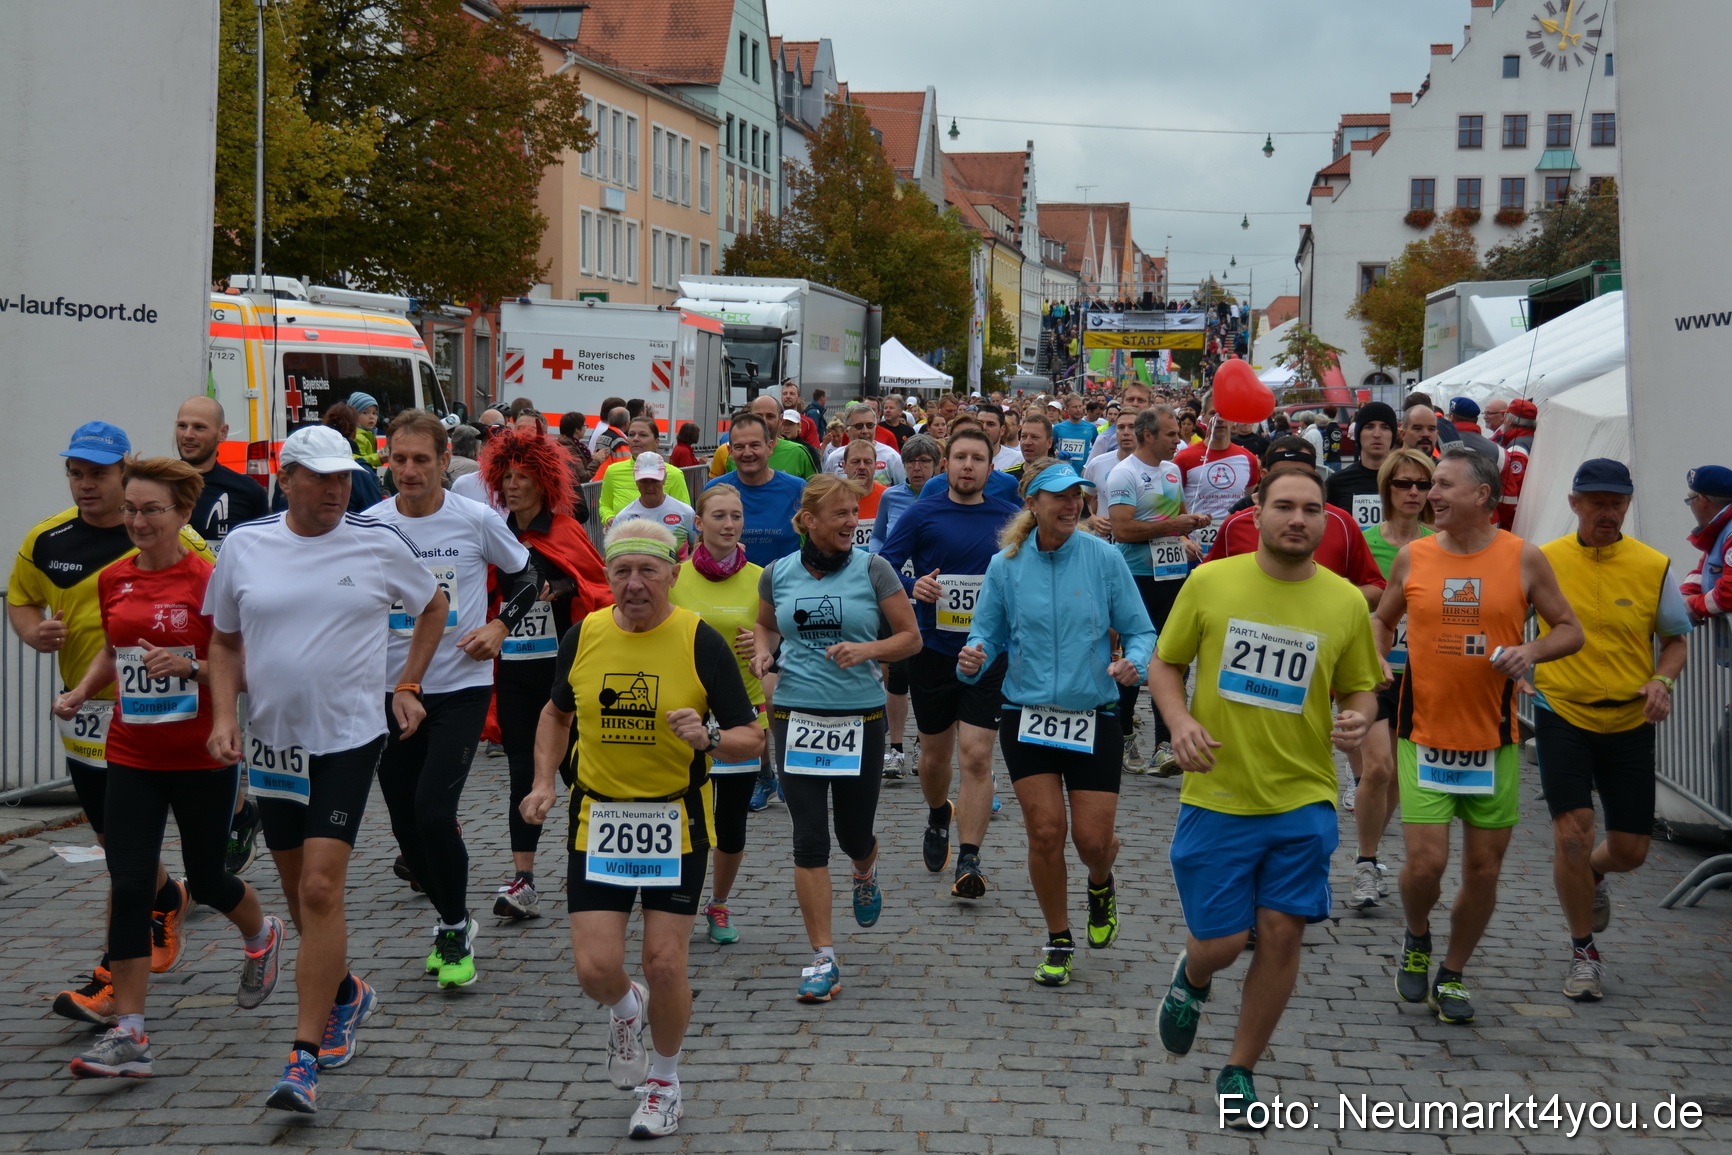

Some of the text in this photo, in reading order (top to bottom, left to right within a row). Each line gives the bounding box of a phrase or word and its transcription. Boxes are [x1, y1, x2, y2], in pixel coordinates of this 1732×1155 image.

[1122, 336, 1164, 346] START
[578, 350, 636, 362] Bayerisches
[578, 361, 605, 371] Rotes
[302, 376, 330, 392] Bayerisches
[577, 373, 605, 383] Kreuz
[883, 376, 921, 386] Laufsport
[1063, 443, 1083, 452] 2577
[49, 559, 83, 572] Jürgen
[1442, 607, 1480, 615] HIRSCH
[800, 630, 842, 640] HIRSCH
[1229, 626, 1303, 648] PARTL Neumarkt
[1230, 640, 1307, 682] 2110
[1245, 680, 1279, 698] Robin
[132, 700, 178, 713] Cornelia
[1024, 704, 1084, 716] PARTL Neumarkt
[600, 718, 656, 731] HIRSCH
[1027, 713, 1089, 743] 2612
[794, 726, 856, 752] 2264
[815, 756, 831, 767] Pia
[263, 774, 296, 791] Werner
[1430, 768, 1464, 784] KURT
[622, 811, 665, 819] Neumarkt
[597, 823, 673, 854] 2693
[606, 861, 662, 877] Wolfgang
